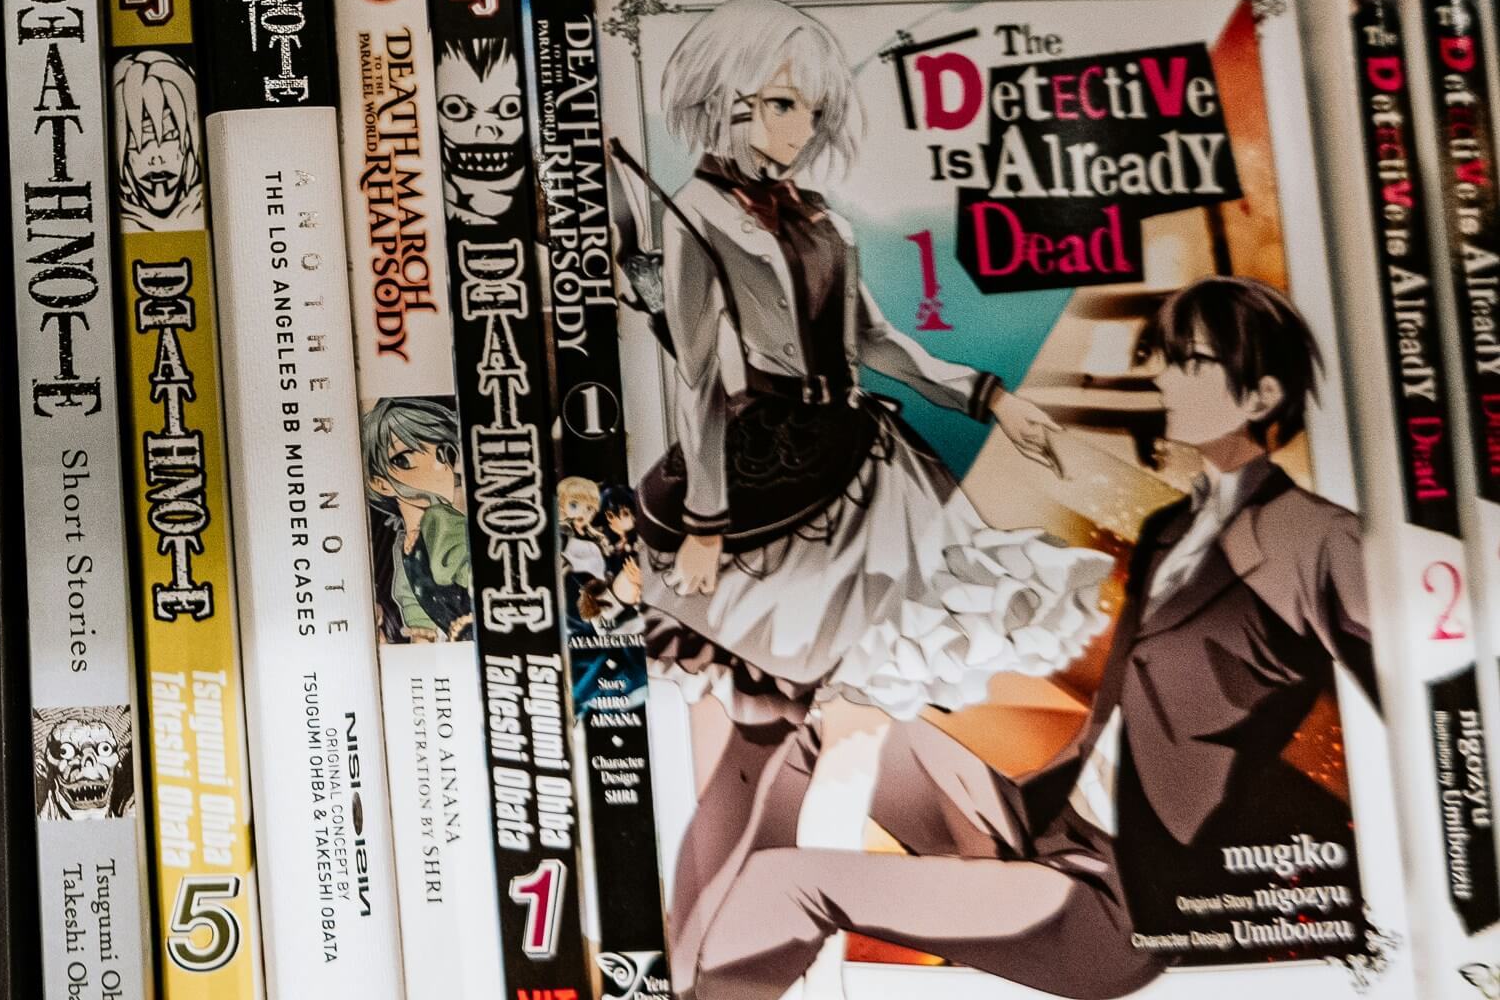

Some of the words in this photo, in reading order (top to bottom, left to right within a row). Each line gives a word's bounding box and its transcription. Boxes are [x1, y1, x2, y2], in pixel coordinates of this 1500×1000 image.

[359, 33, 374, 100] PARALLEL
[537, 19, 553, 88] PARALLEL
[994, 24, 1062, 57] The
[377, 27, 421, 159] DEATH
[543, 90, 557, 142] WORLD
[556, 14, 601, 147] DEATH
[363, 102, 378, 152] WORLD
[927, 144, 973, 181] Is
[265, 171, 284, 216] THE
[269, 227, 288, 270] LOS
[360, 154, 409, 363] RHAPSODY
[394, 168, 438, 314] MARCH
[544, 144, 588, 357] RHAPSODY
[573, 159, 618, 309] MARCH
[968, 201, 1134, 277] Dead
[904, 229, 954, 331] 1
[273, 280, 297, 391] ANGELES
[281, 402, 300, 433] BB
[580, 386, 604, 434] 1
[62, 449, 90, 543] Short
[285, 444, 308, 546] MURDER
[1407, 415, 1449, 501] Dead
[67, 554, 96, 673] Stories
[293, 558, 315, 636] CASES
[1422, 561, 1466, 640] 2
[303, 671, 322, 750] TSUGUMI
[434, 677, 453, 739] HIRO
[485, 655, 530, 762] Takeshi
[524, 653, 570, 771] Tsugumi
[590, 712, 642, 727] AINANA
[597, 677, 628, 692] Story
[152, 671, 192, 779] Takeshi
[189, 670, 233, 787] Tsugumi
[411, 677, 431, 811] ILLUSTRATION
[592, 756, 645, 769] Character
[309, 756, 325, 804] OHBA
[325, 727, 342, 800] ORIGINAL
[439, 749, 460, 844] AINANA
[601, 771, 640, 786] Design
[604, 789, 639, 804] SHRI
[1458, 709, 1493, 828] nigozyu
[331, 804, 349, 877] CONCEPT
[421, 816, 434, 840] BY
[491, 766, 535, 851] Obata
[535, 775, 575, 849] Ohba
[1442, 789, 1474, 901] Umibouzu
[314, 826, 333, 901] TAKESHI
[337, 882, 350, 901] BY
[424, 845, 443, 904] SHRI
[1222, 834, 1348, 878] mugiko
[63, 864, 86, 954] Takeshi
[91, 859, 119, 962] Tsugumi
[167, 874, 240, 972] 5
[321, 907, 338, 963] OBATA
[508, 858, 567, 962] 1
[1132, 930, 1190, 949] Character
[1231, 917, 1355, 949] Umibouzu
[1176, 894, 1223, 915] Original
[1254, 883, 1351, 916] nigozyu
